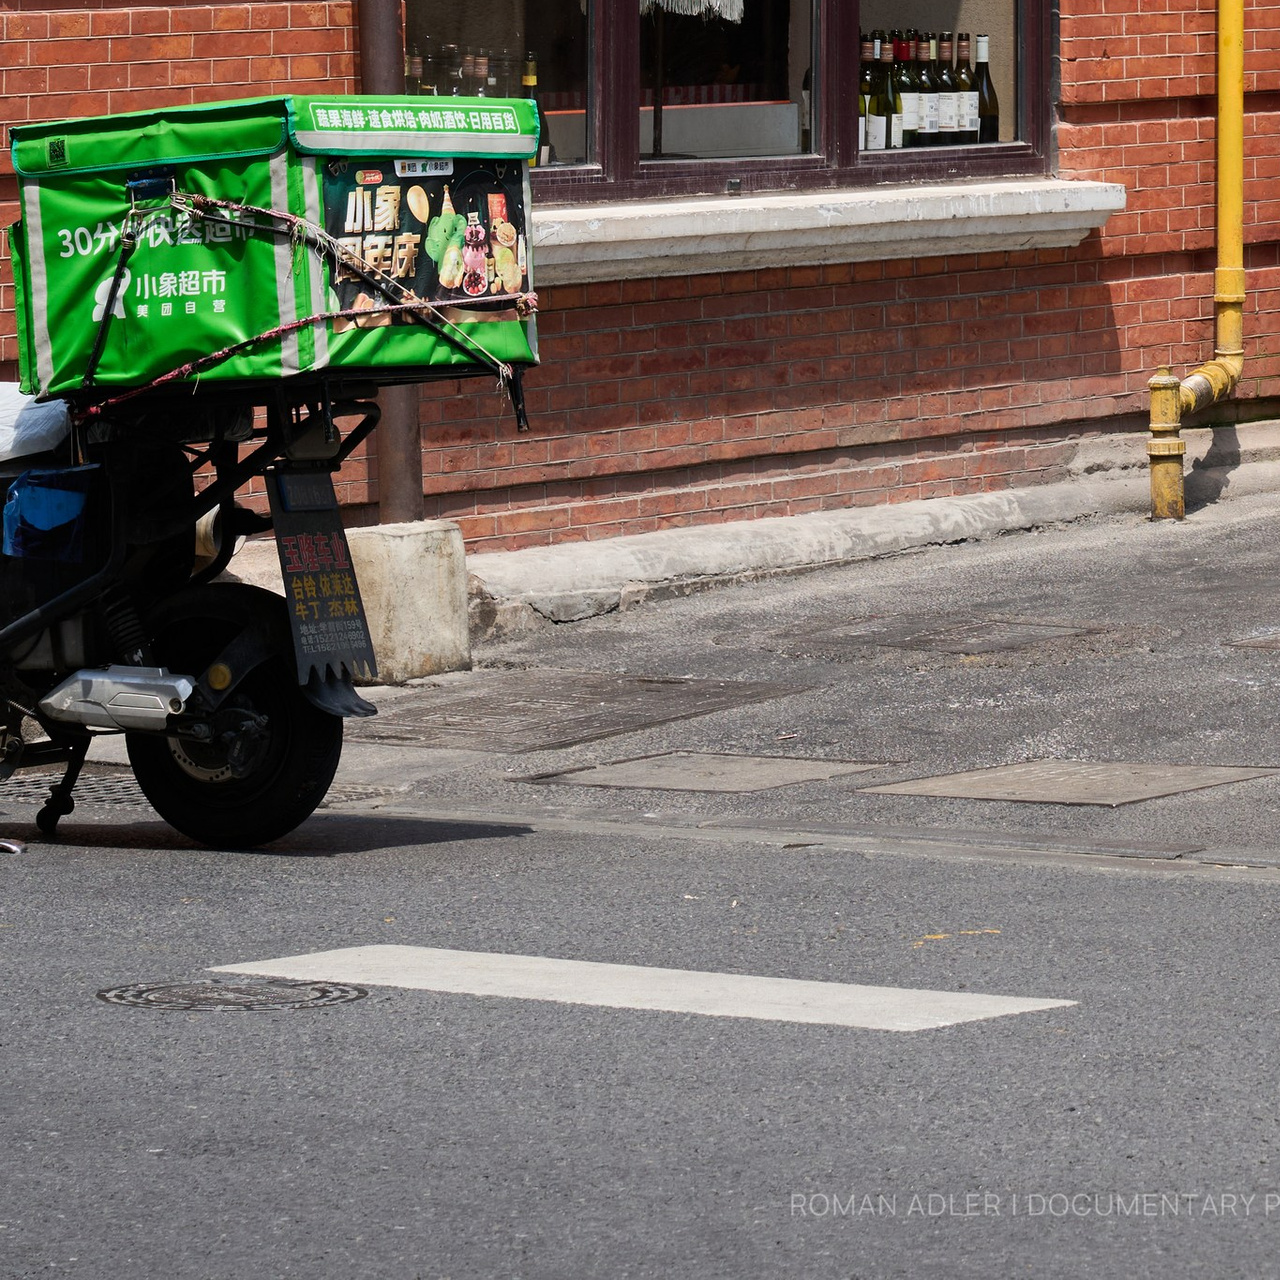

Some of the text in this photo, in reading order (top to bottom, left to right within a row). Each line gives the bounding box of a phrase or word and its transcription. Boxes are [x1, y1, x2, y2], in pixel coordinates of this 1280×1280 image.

[344, 184, 401, 234] 小象
[136, 269, 227, 300] 小象超市
